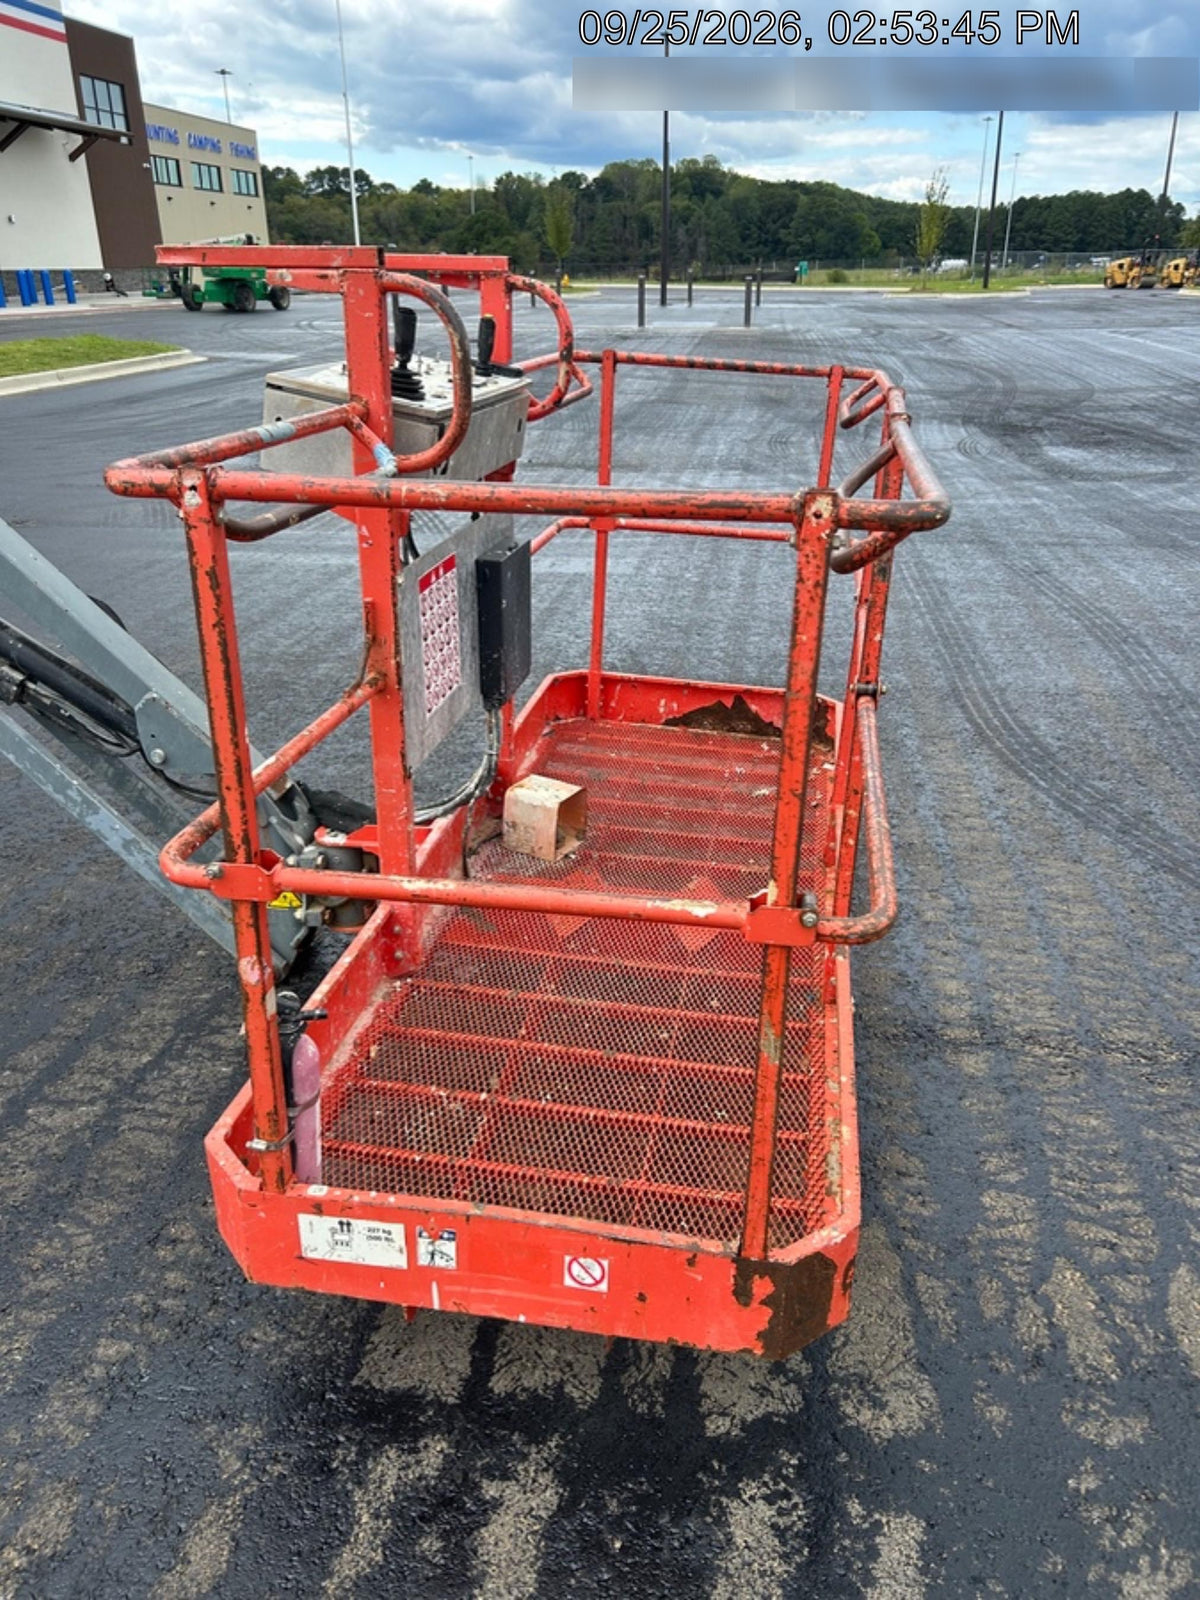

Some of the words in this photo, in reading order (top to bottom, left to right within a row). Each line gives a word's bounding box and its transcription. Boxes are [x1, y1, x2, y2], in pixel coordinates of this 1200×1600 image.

[145, 123, 180, 145] UNTING
[187, 132, 222, 154] CAMPING
[229, 141, 256, 160] FISHING
